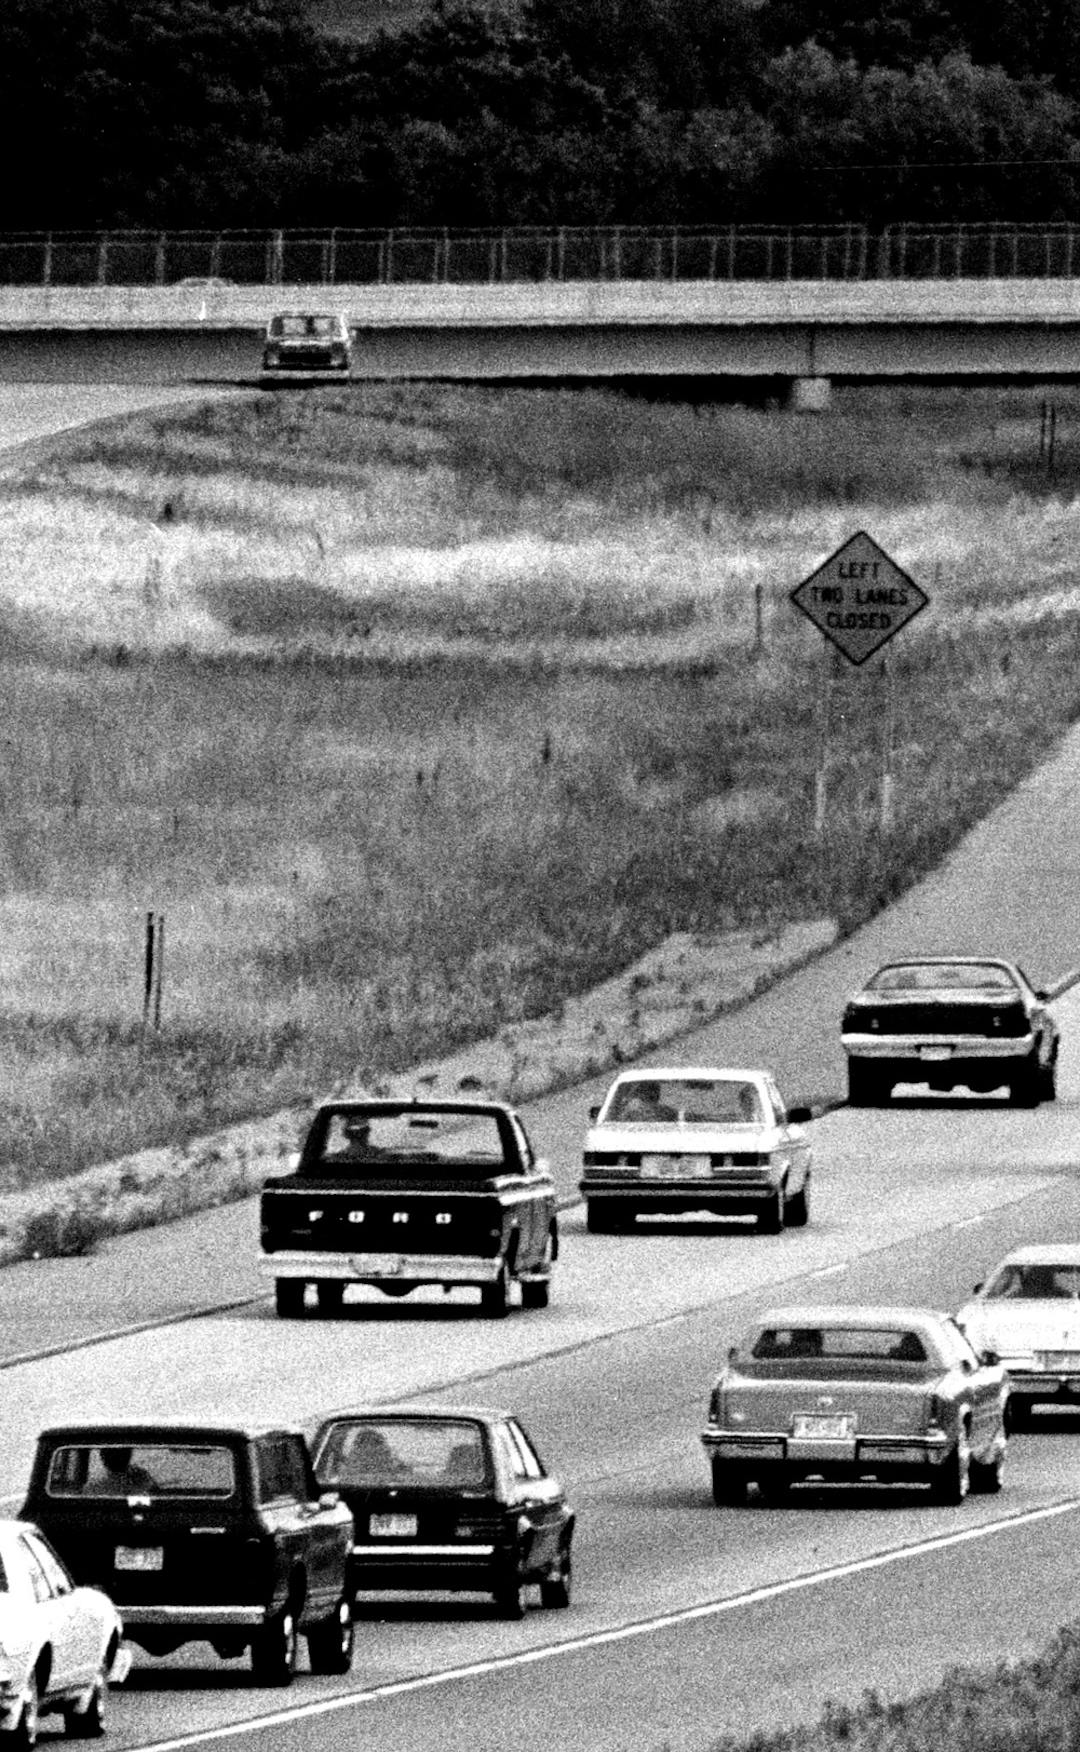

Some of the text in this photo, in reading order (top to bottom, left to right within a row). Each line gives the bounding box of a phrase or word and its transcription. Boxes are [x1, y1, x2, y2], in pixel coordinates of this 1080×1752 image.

[839, 562, 880, 579] LEFT
[812, 586, 907, 605] TWO LANES
[827, 612, 891, 629] CLOSED
[308, 1210, 452, 1225] FORD
